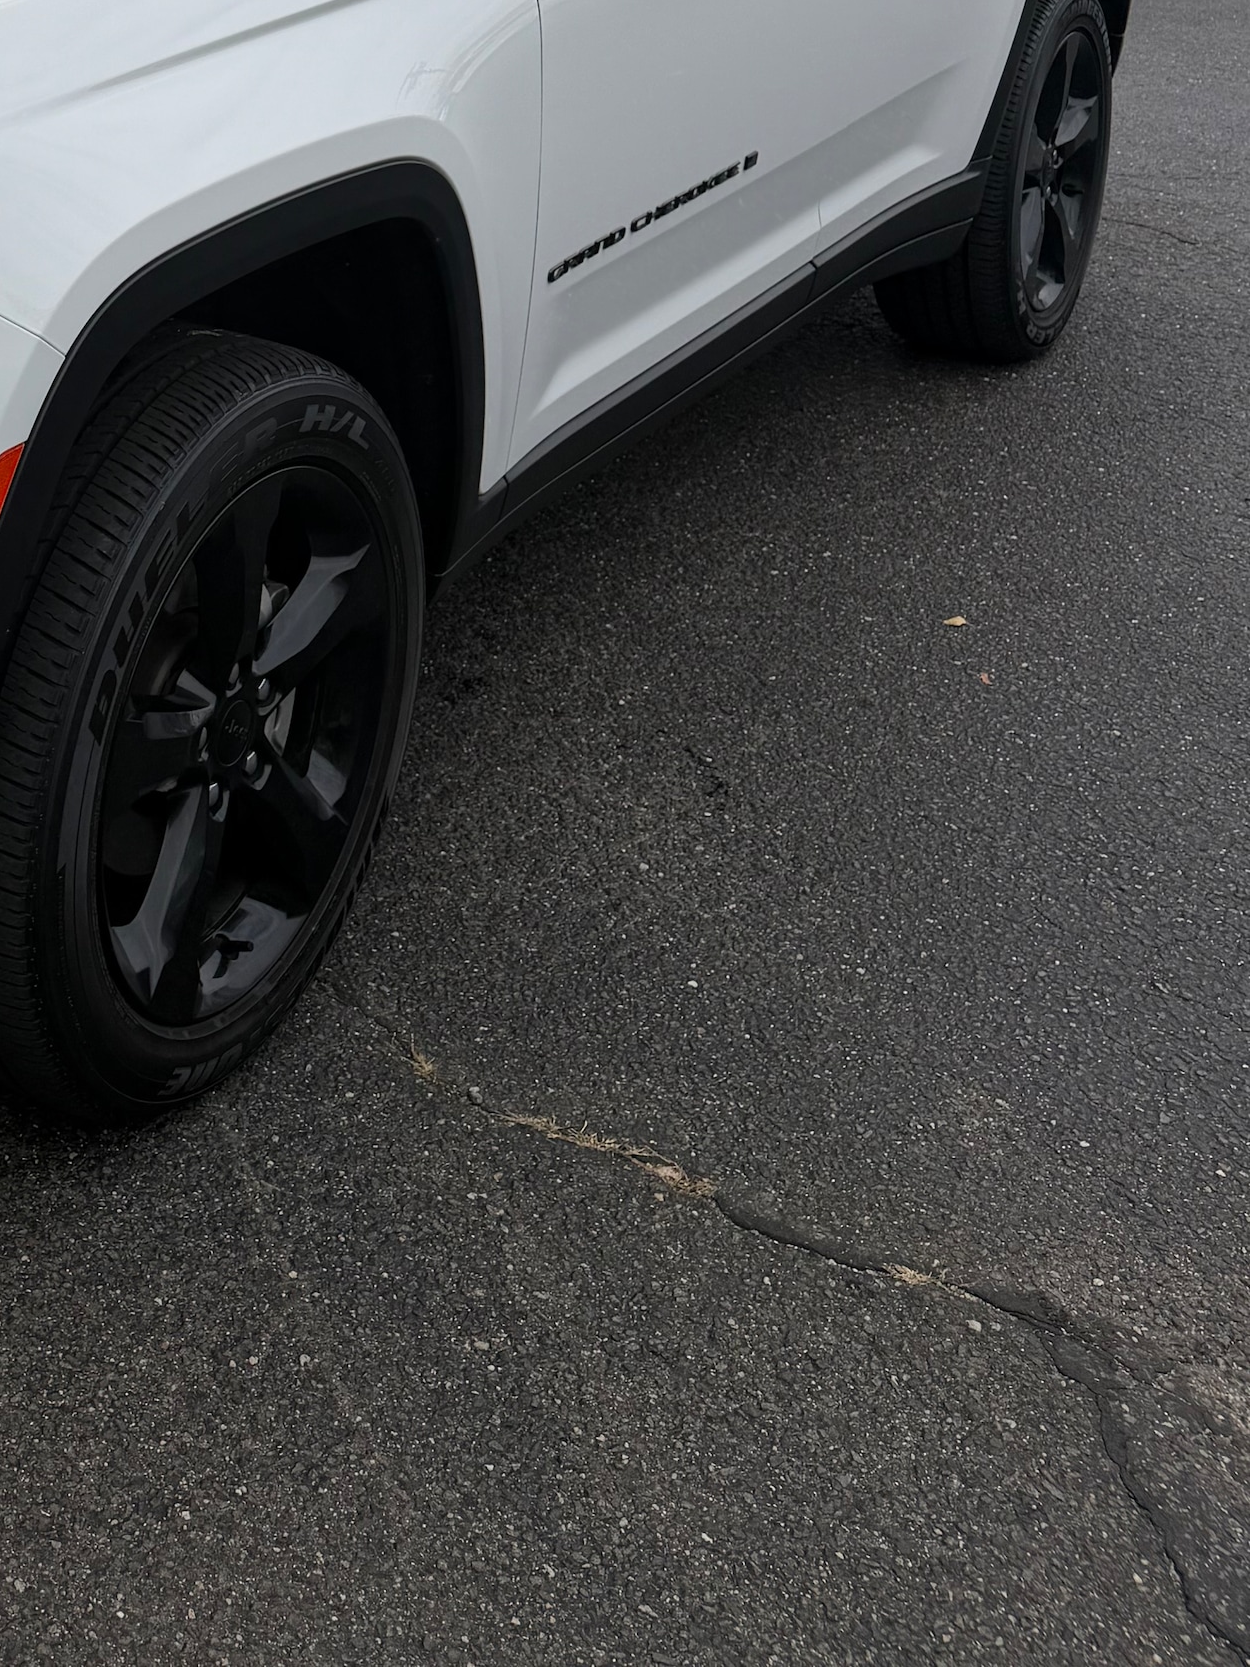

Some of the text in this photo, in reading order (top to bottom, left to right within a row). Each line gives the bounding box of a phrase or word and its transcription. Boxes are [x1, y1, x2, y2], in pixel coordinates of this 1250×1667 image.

[547, 160, 741, 284] GRAND CHEROKEE
[299, 403, 372, 451] H/L
